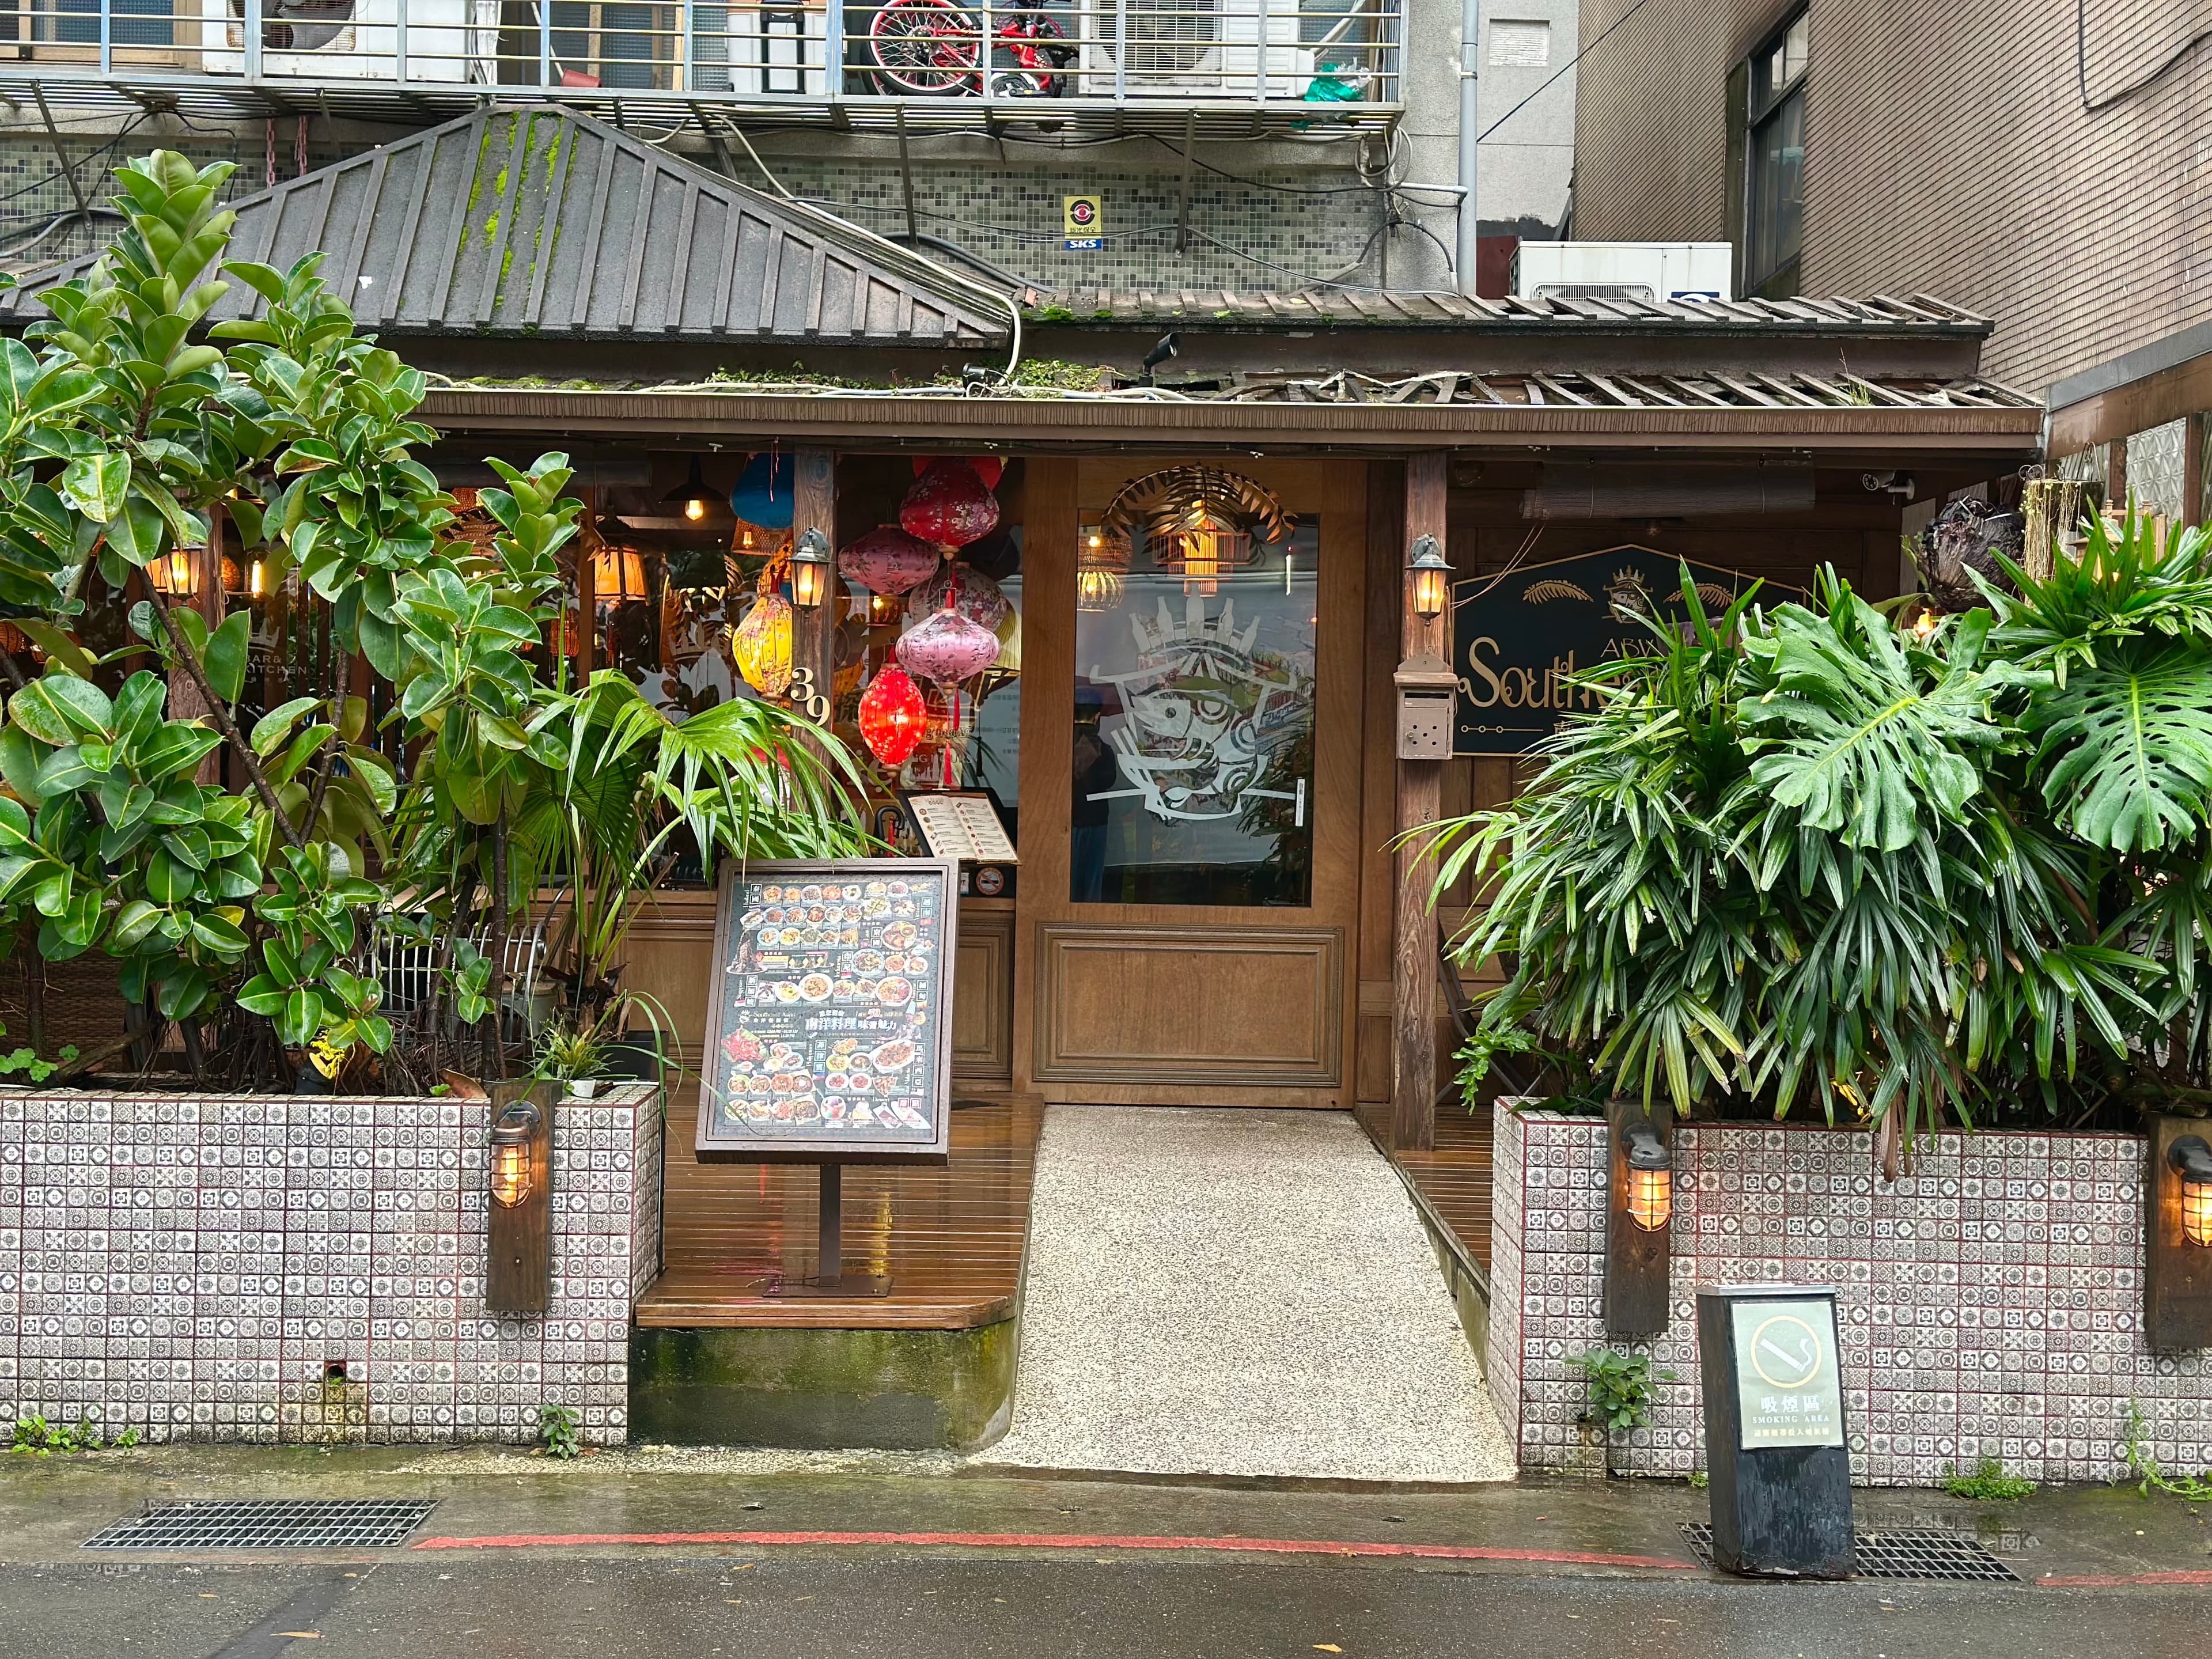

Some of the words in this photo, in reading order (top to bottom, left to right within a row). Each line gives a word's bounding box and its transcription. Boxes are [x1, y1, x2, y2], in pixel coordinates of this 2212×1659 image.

[1070, 240, 1097, 248] SKS
[246, 665, 306, 675] KITCHEN
[791, 668, 830, 726] 39
[842, 952, 852, 971] 印尼
[1760, 1395, 1820, 1414] 吸煙區
[1752, 1415, 1798, 1424] SMOKING
[1804, 1414, 1830, 1422] AREA
